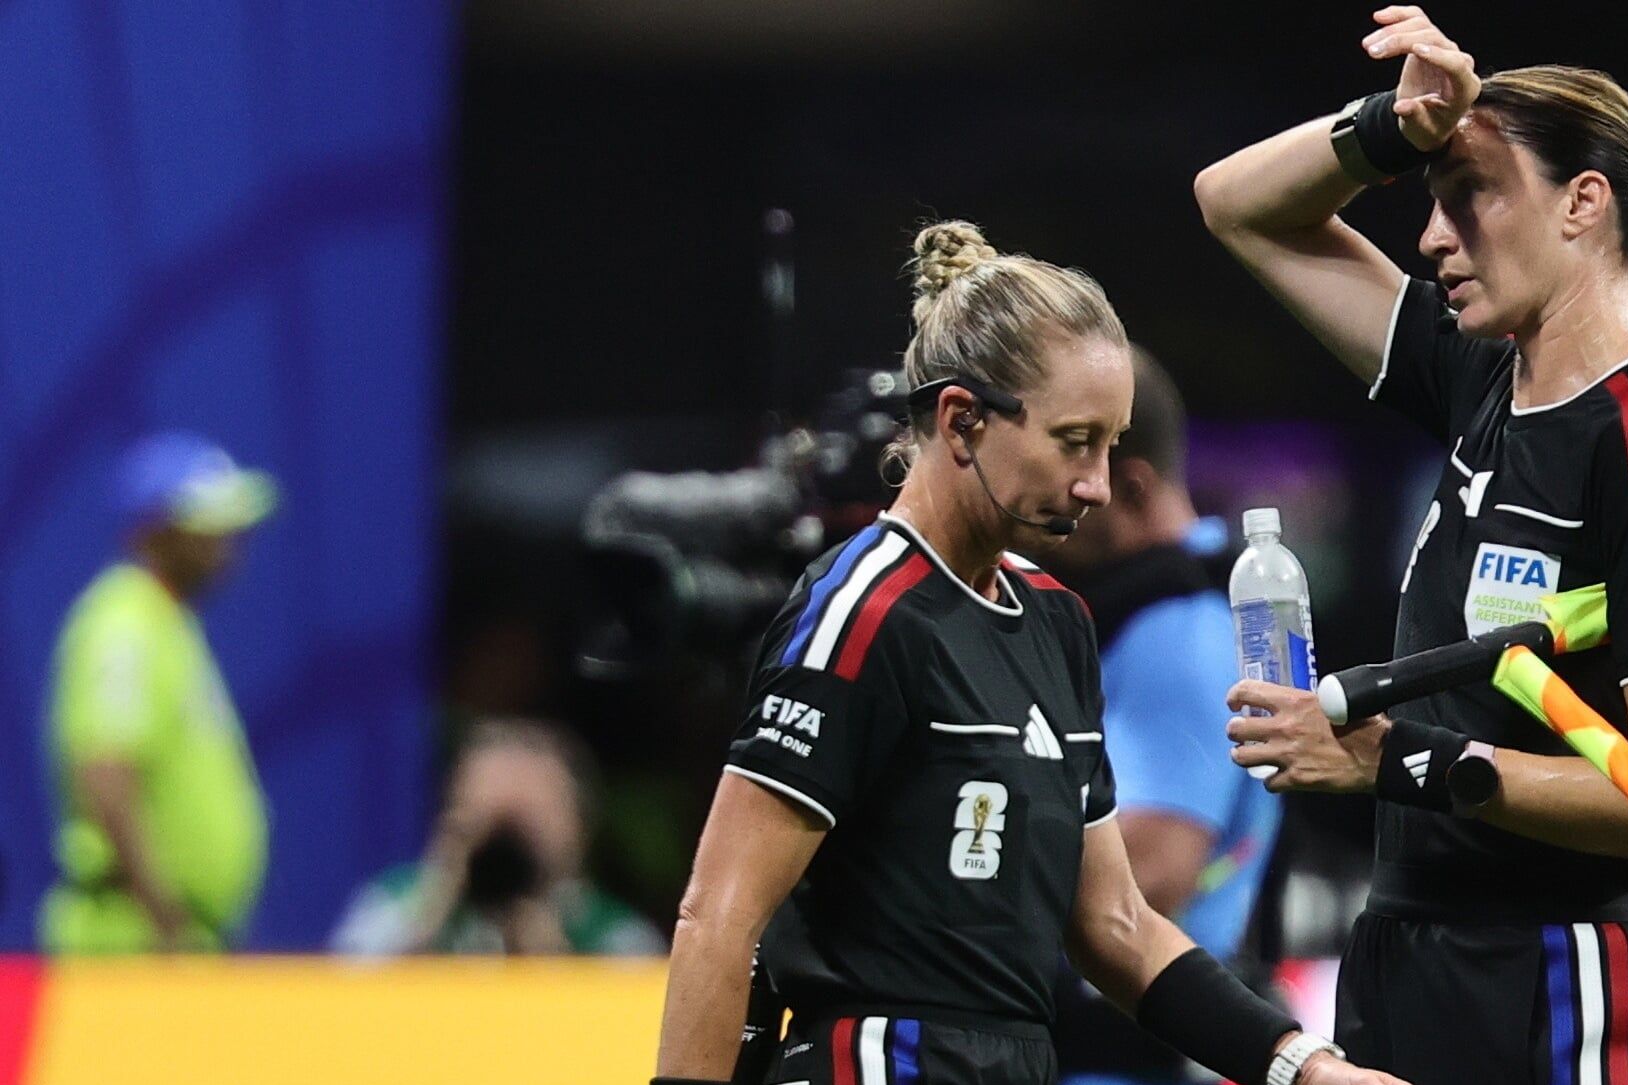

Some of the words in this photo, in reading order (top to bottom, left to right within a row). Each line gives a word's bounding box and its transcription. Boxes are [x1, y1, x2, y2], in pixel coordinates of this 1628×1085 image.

[1478, 552, 1548, 589] FIFA
[1474, 607, 1536, 625] REFERE
[761, 693, 823, 739] FIFA
[781, 734, 813, 758] ONE
[964, 858, 987, 870] FIFA
